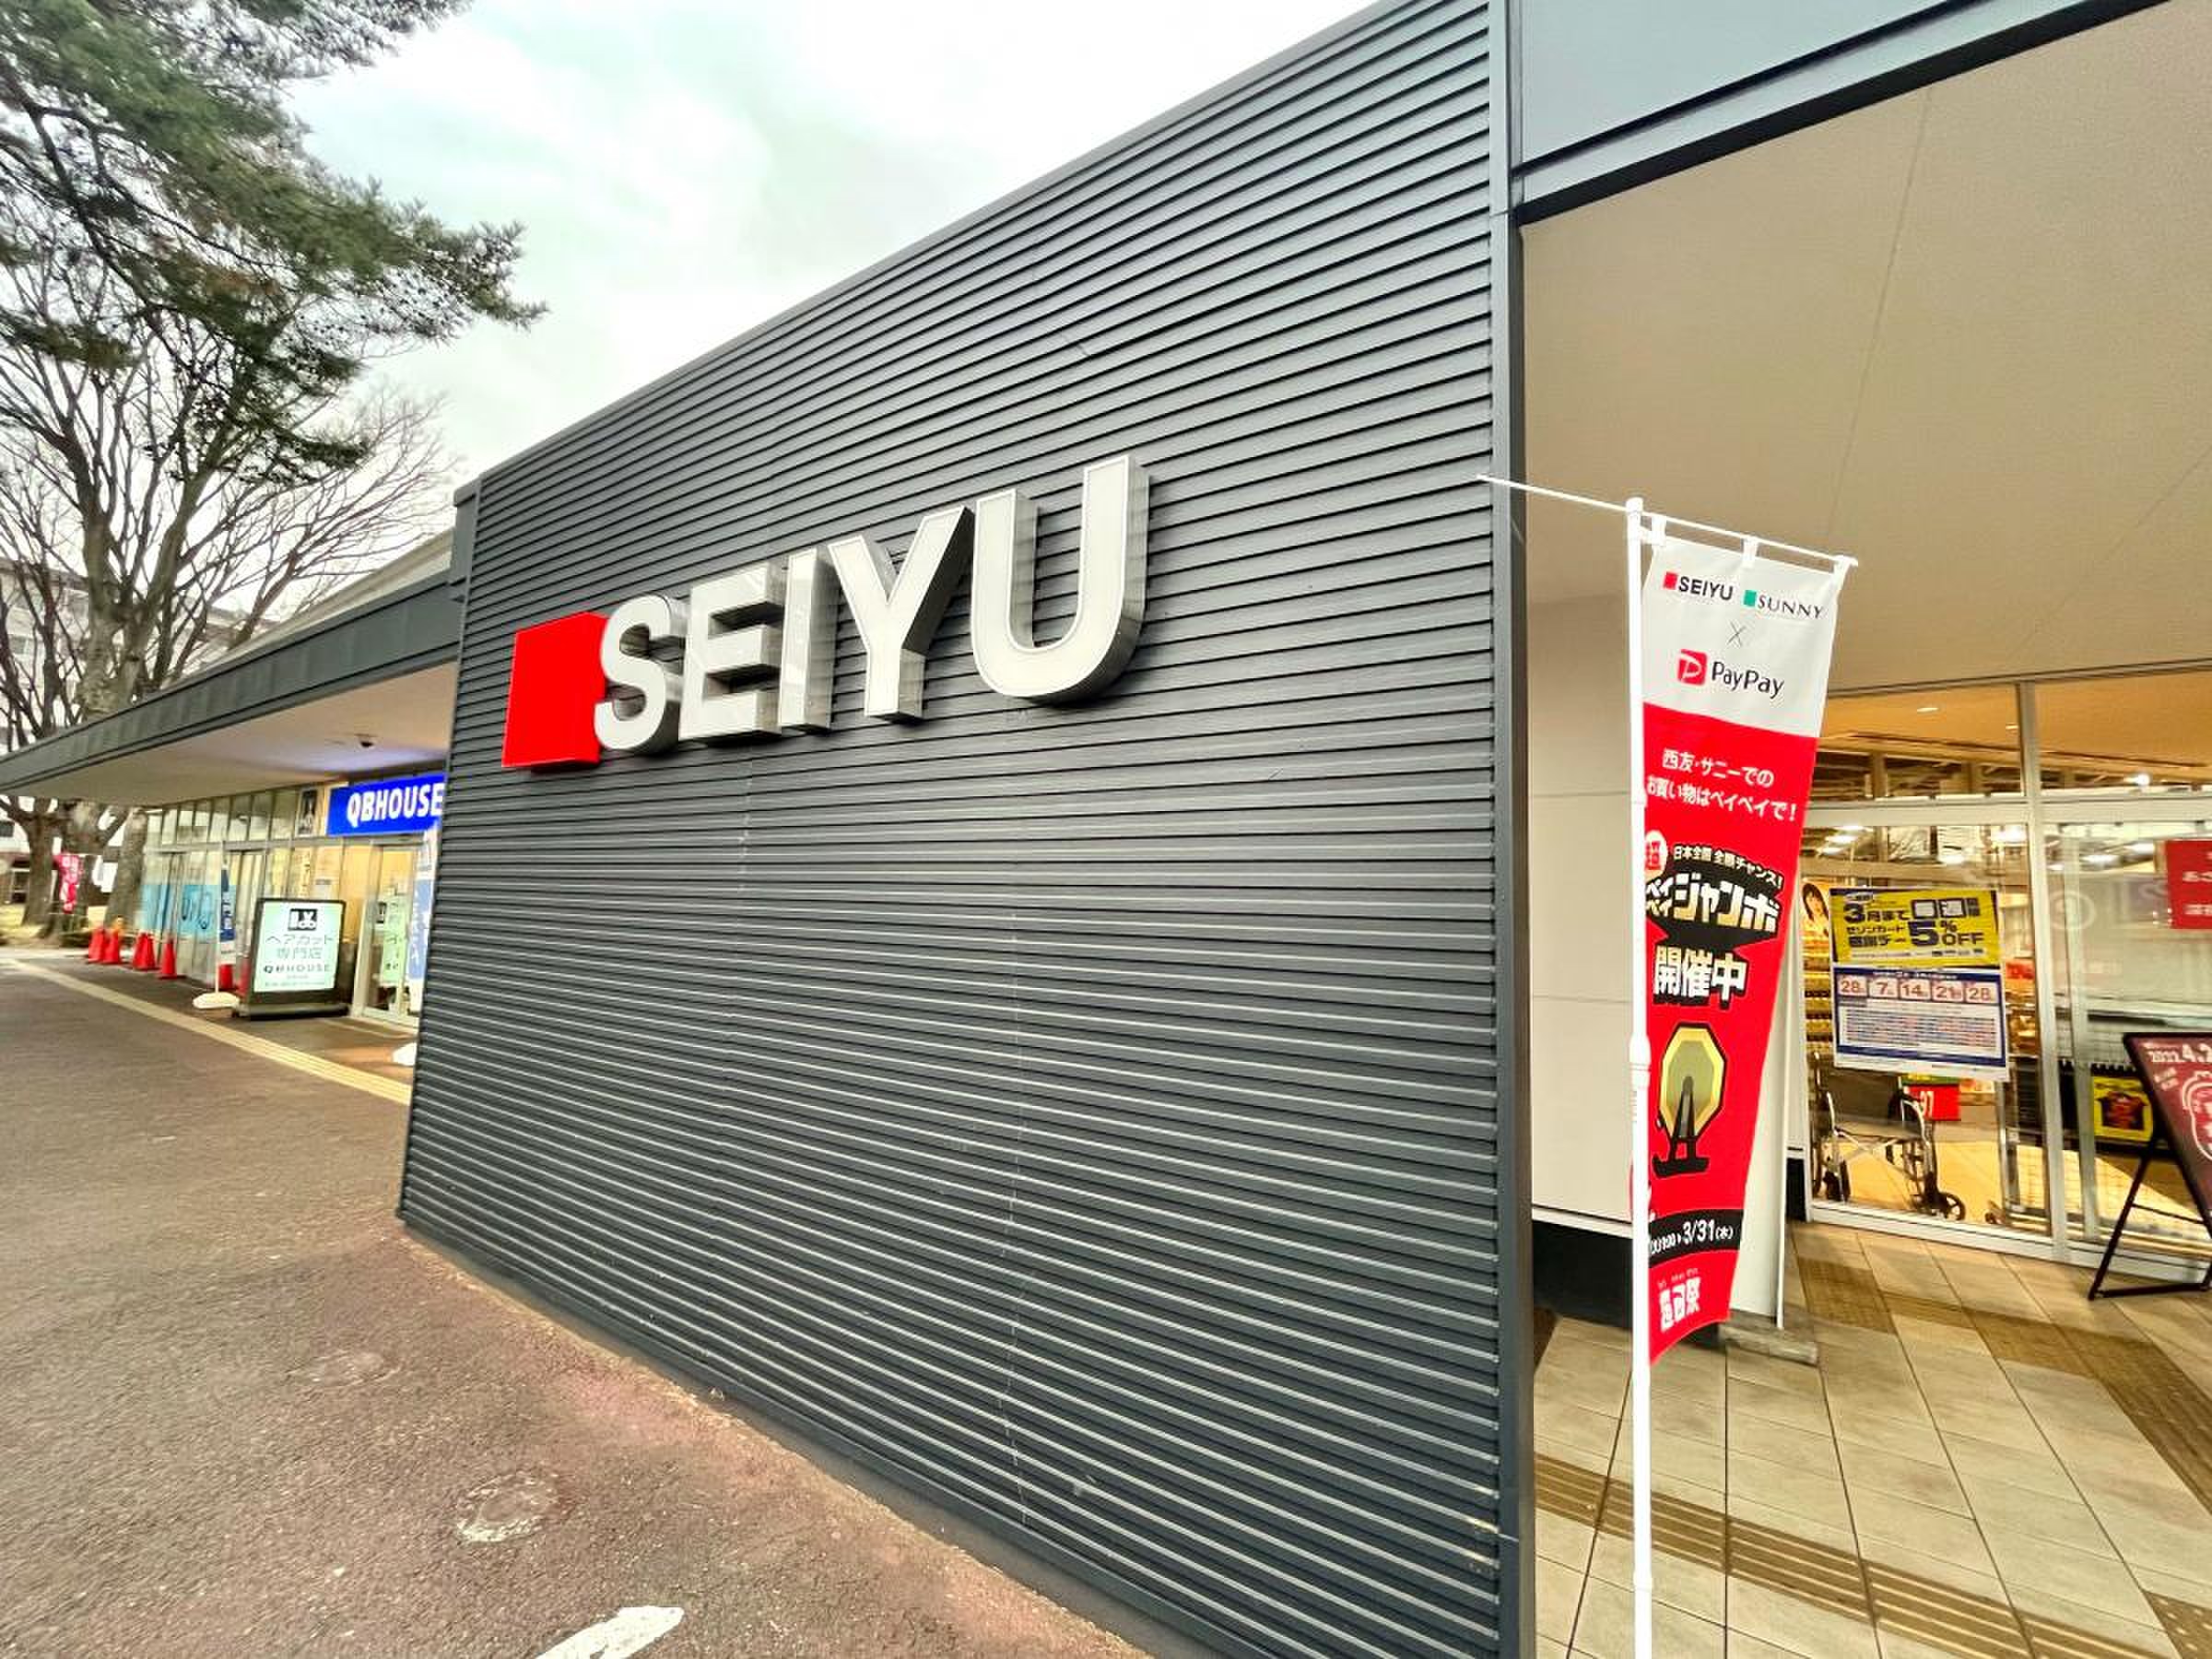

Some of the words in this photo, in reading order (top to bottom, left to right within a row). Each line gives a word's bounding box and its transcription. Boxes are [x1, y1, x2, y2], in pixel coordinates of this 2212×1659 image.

[593, 454, 1148, 754] SEIYU
[1677, 576, 1734, 601] SEIYU
[1757, 594, 1824, 618] SUNNY
[1712, 661, 1784, 699] PayPay
[347, 782, 444, 828] QBHOUSE
[1942, 933, 1984, 946] OFF
[1653, 946, 1747, 1000] 開催中
